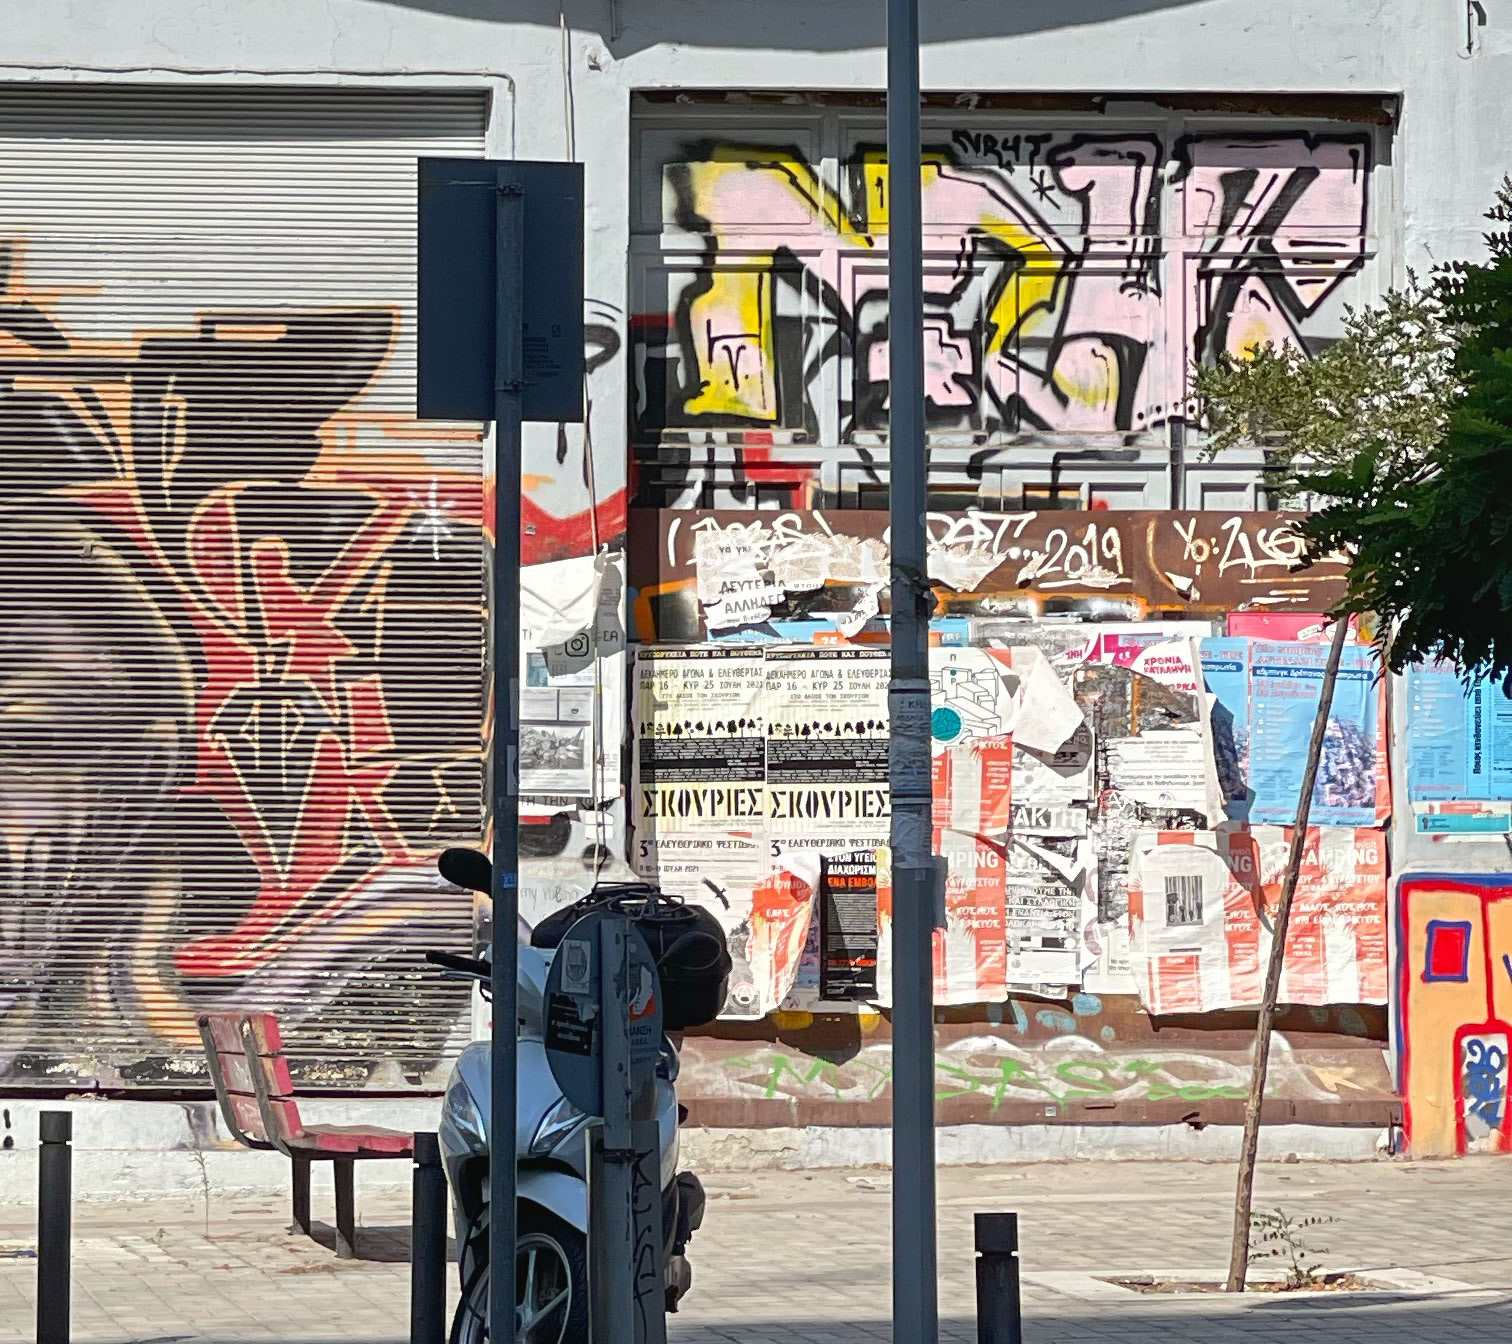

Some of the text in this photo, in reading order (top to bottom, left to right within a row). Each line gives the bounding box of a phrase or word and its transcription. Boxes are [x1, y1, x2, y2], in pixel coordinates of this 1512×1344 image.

[704, 681, 714, 689] 25
[813, 682, 828, 690] ΚΥΡ
[833, 682, 843, 690] 25
[643, 788, 763, 817] ΣΚΟΥΡΙΕΣ
[771, 789, 890, 818] ΣΚΟΥΡΙΕΣ
[828, 877, 846, 887] ΕΝΑ
